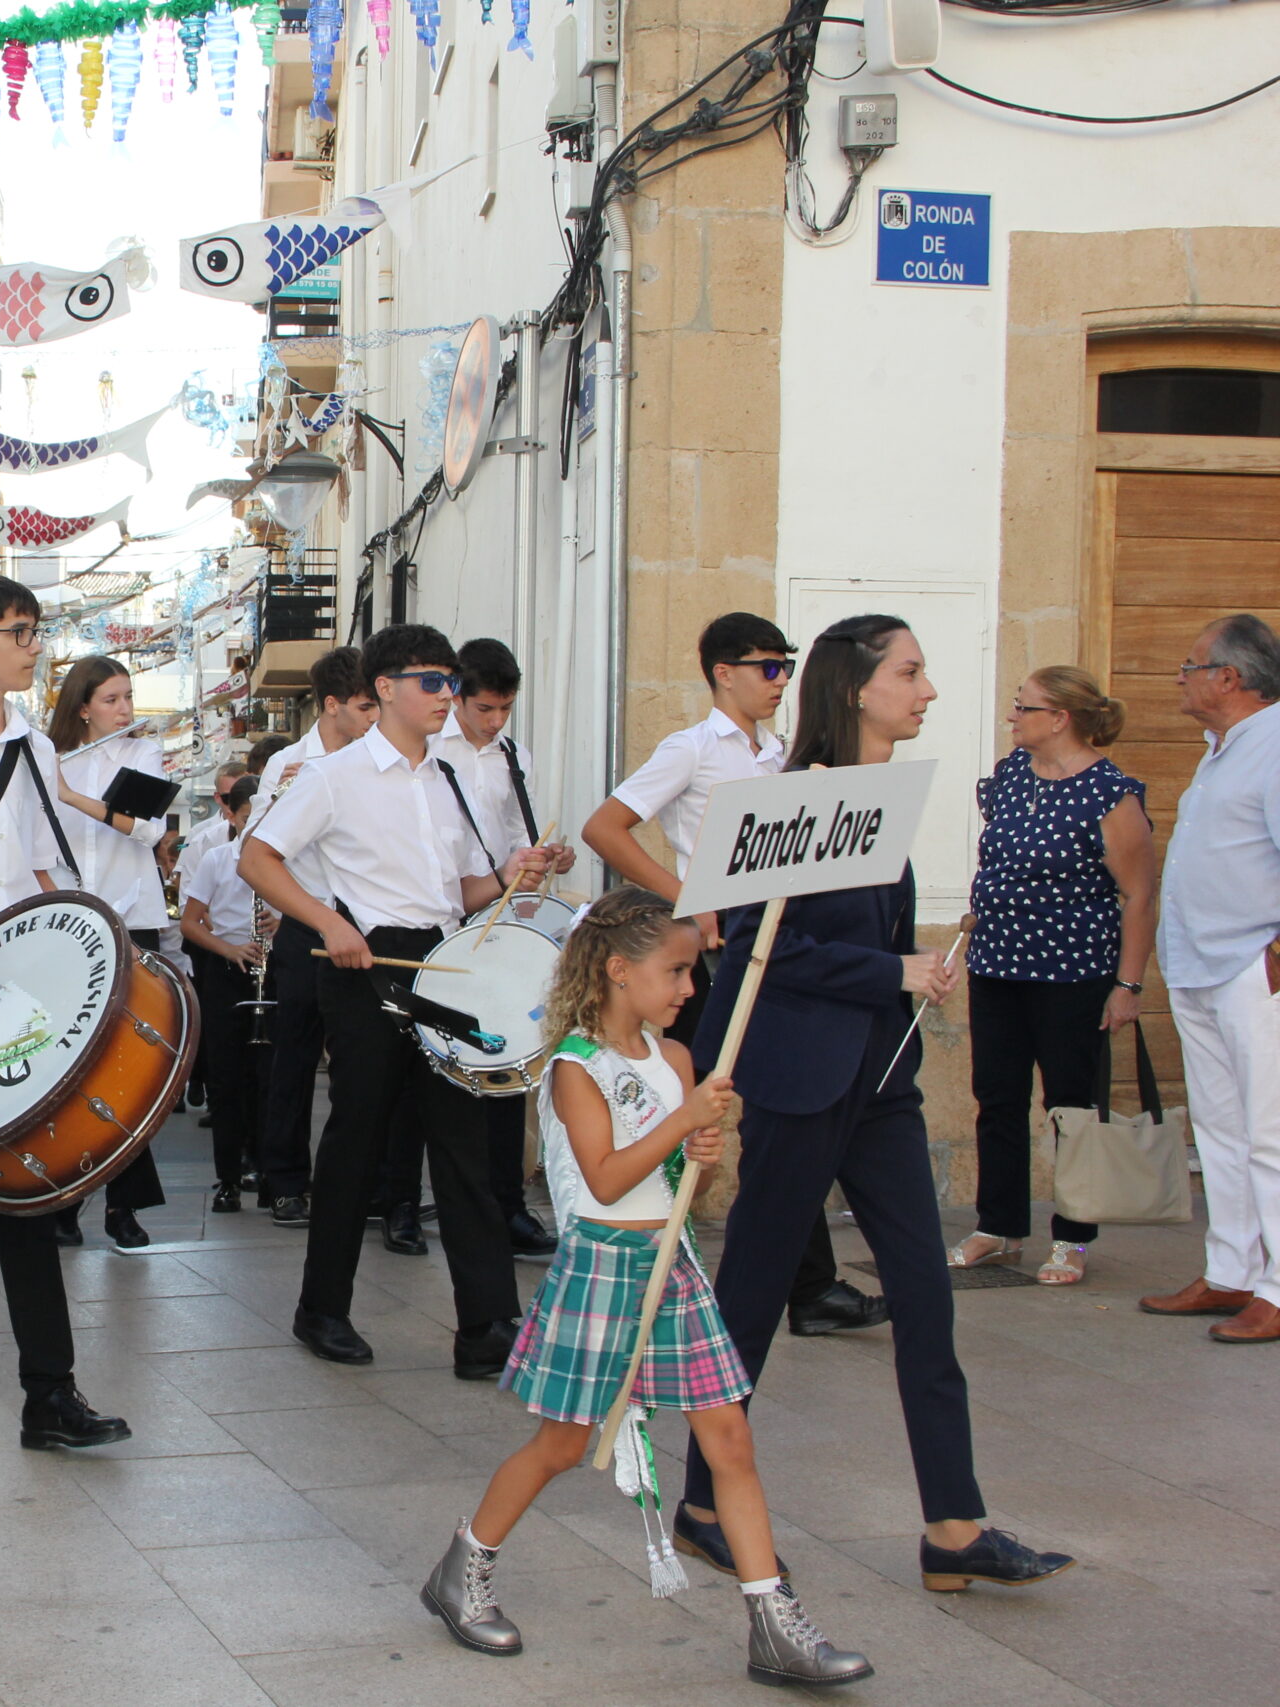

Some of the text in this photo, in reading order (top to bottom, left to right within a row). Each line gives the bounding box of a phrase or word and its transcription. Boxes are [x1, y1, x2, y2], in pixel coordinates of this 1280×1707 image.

[915, 205, 975, 226] RONDA
[922, 235, 946, 254] DE
[903, 258, 964, 281] COLÓN
[726, 800, 882, 876] Banda Jove
[56, 959, 107, 1049] MUSICAL
